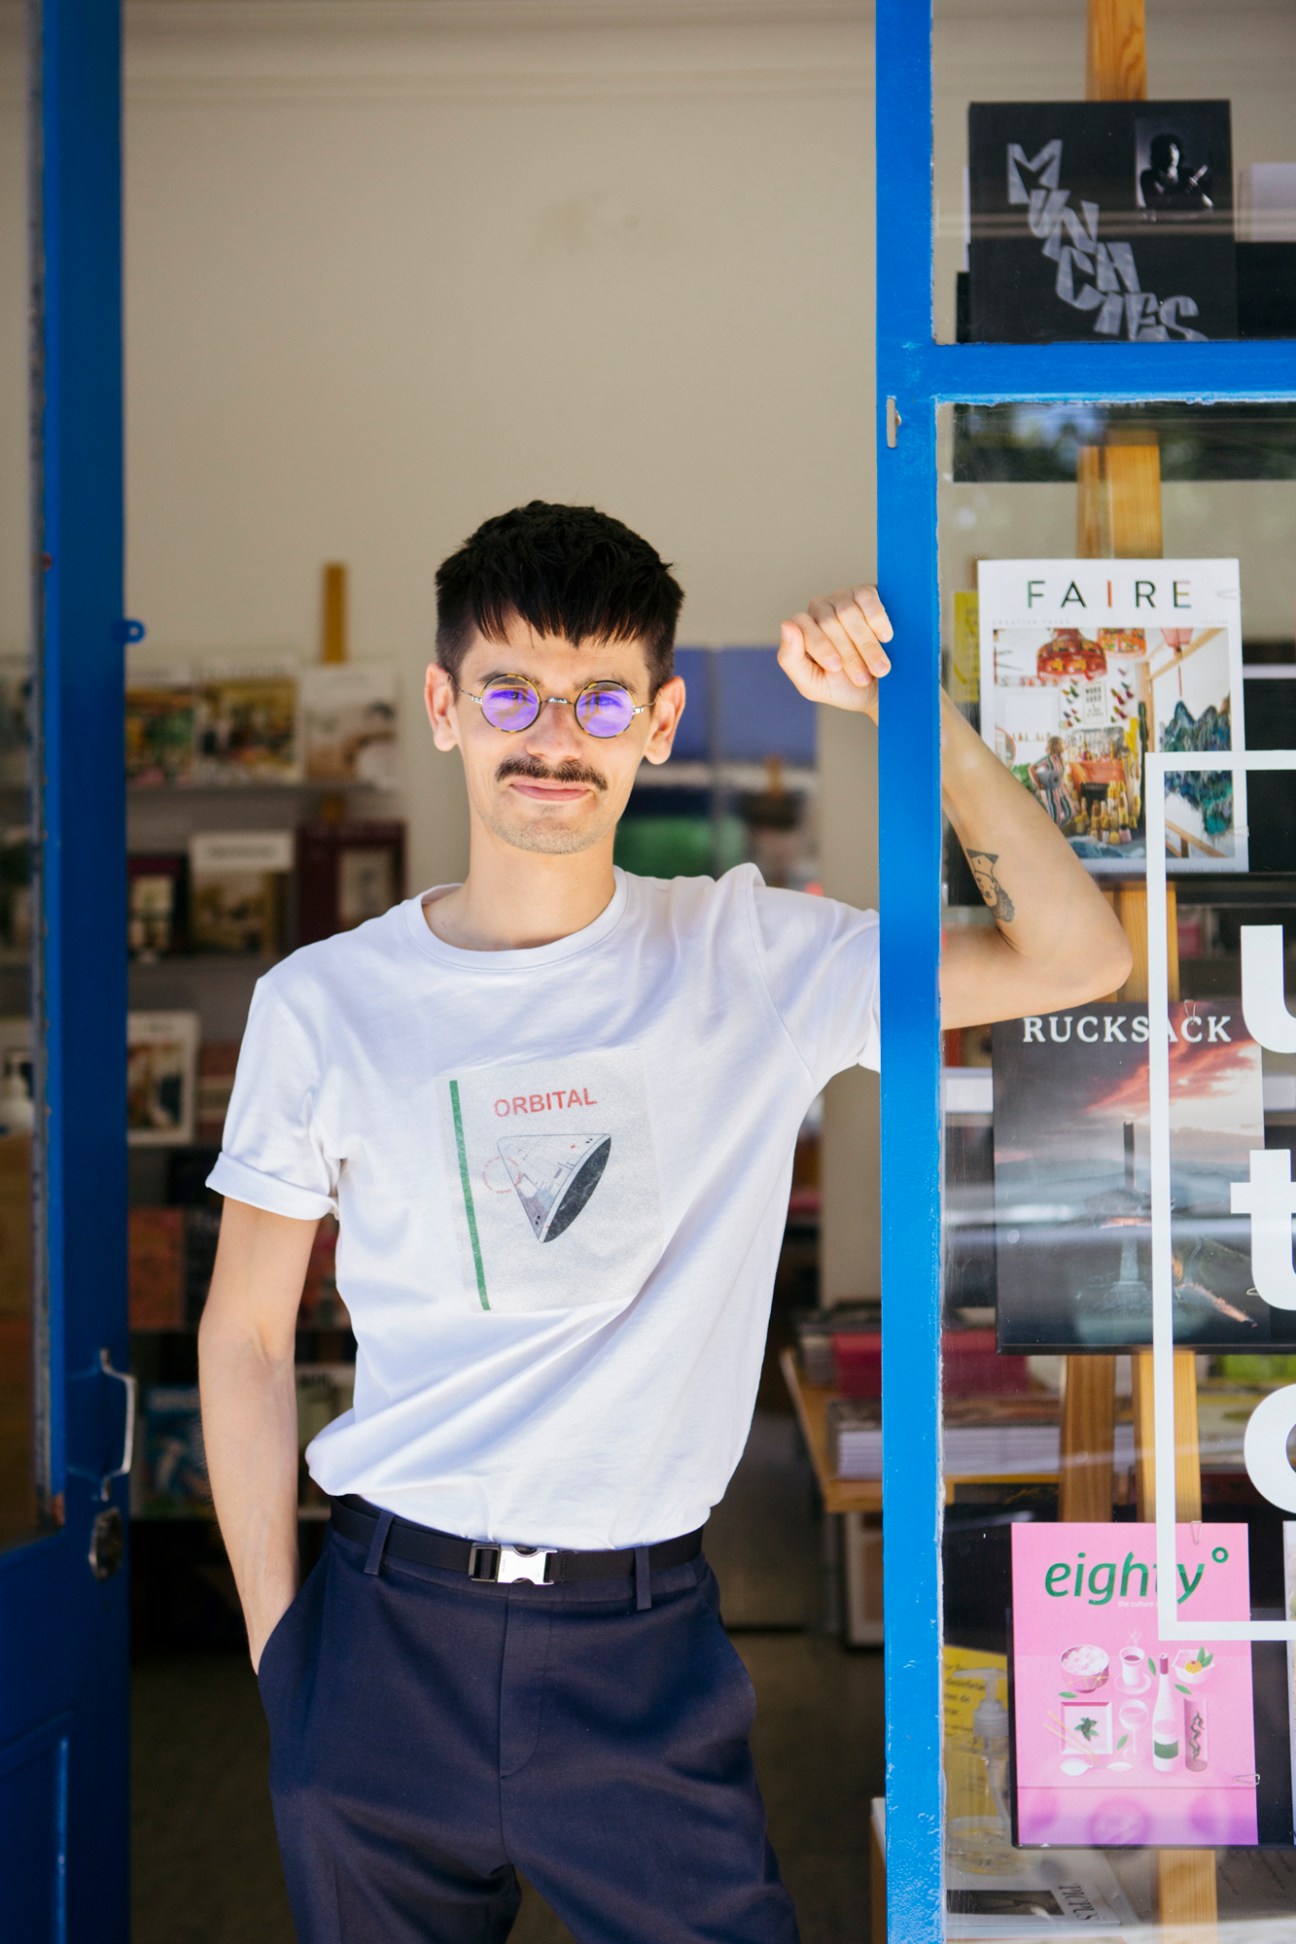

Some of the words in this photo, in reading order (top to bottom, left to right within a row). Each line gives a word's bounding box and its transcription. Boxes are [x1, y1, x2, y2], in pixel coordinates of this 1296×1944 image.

[1007, 138, 1209, 341] MUNCHIES
[1026, 580, 1192, 609] FAIRE
[1023, 1016, 1231, 1043] RUCKSCK
[493, 1087, 598, 1118] ORBITAL
